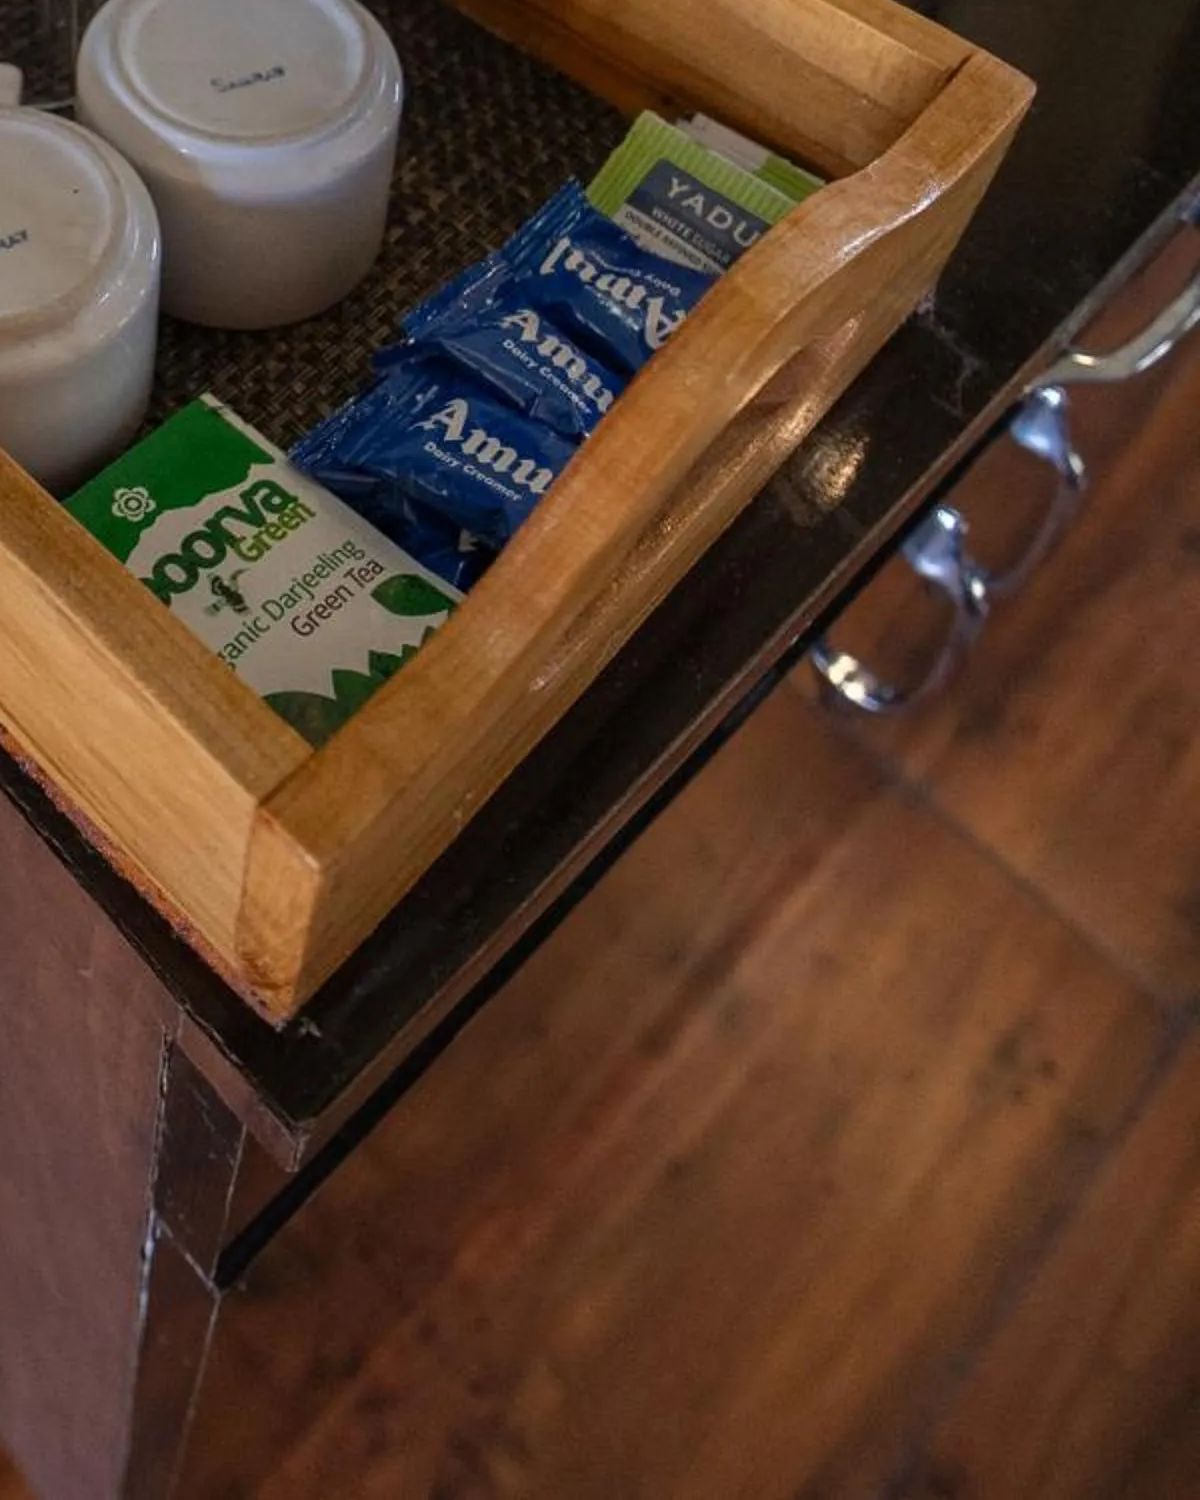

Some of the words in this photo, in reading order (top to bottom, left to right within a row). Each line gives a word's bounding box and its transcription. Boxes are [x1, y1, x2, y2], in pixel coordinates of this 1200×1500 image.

[667, 176, 762, 246] YADU
[539, 236, 687, 350] Amul
[502, 338, 539, 369] Dairy
[502, 309, 614, 412] Amu
[412, 398, 553, 494] Amu
[423, 441, 461, 468] Dairy
[462, 464, 523, 501] Creamer
[235, 501, 316, 562] Green
[261, 540, 366, 622] Darjeeling
[290, 584, 352, 637] Green
[343, 558, 386, 590] Tea
